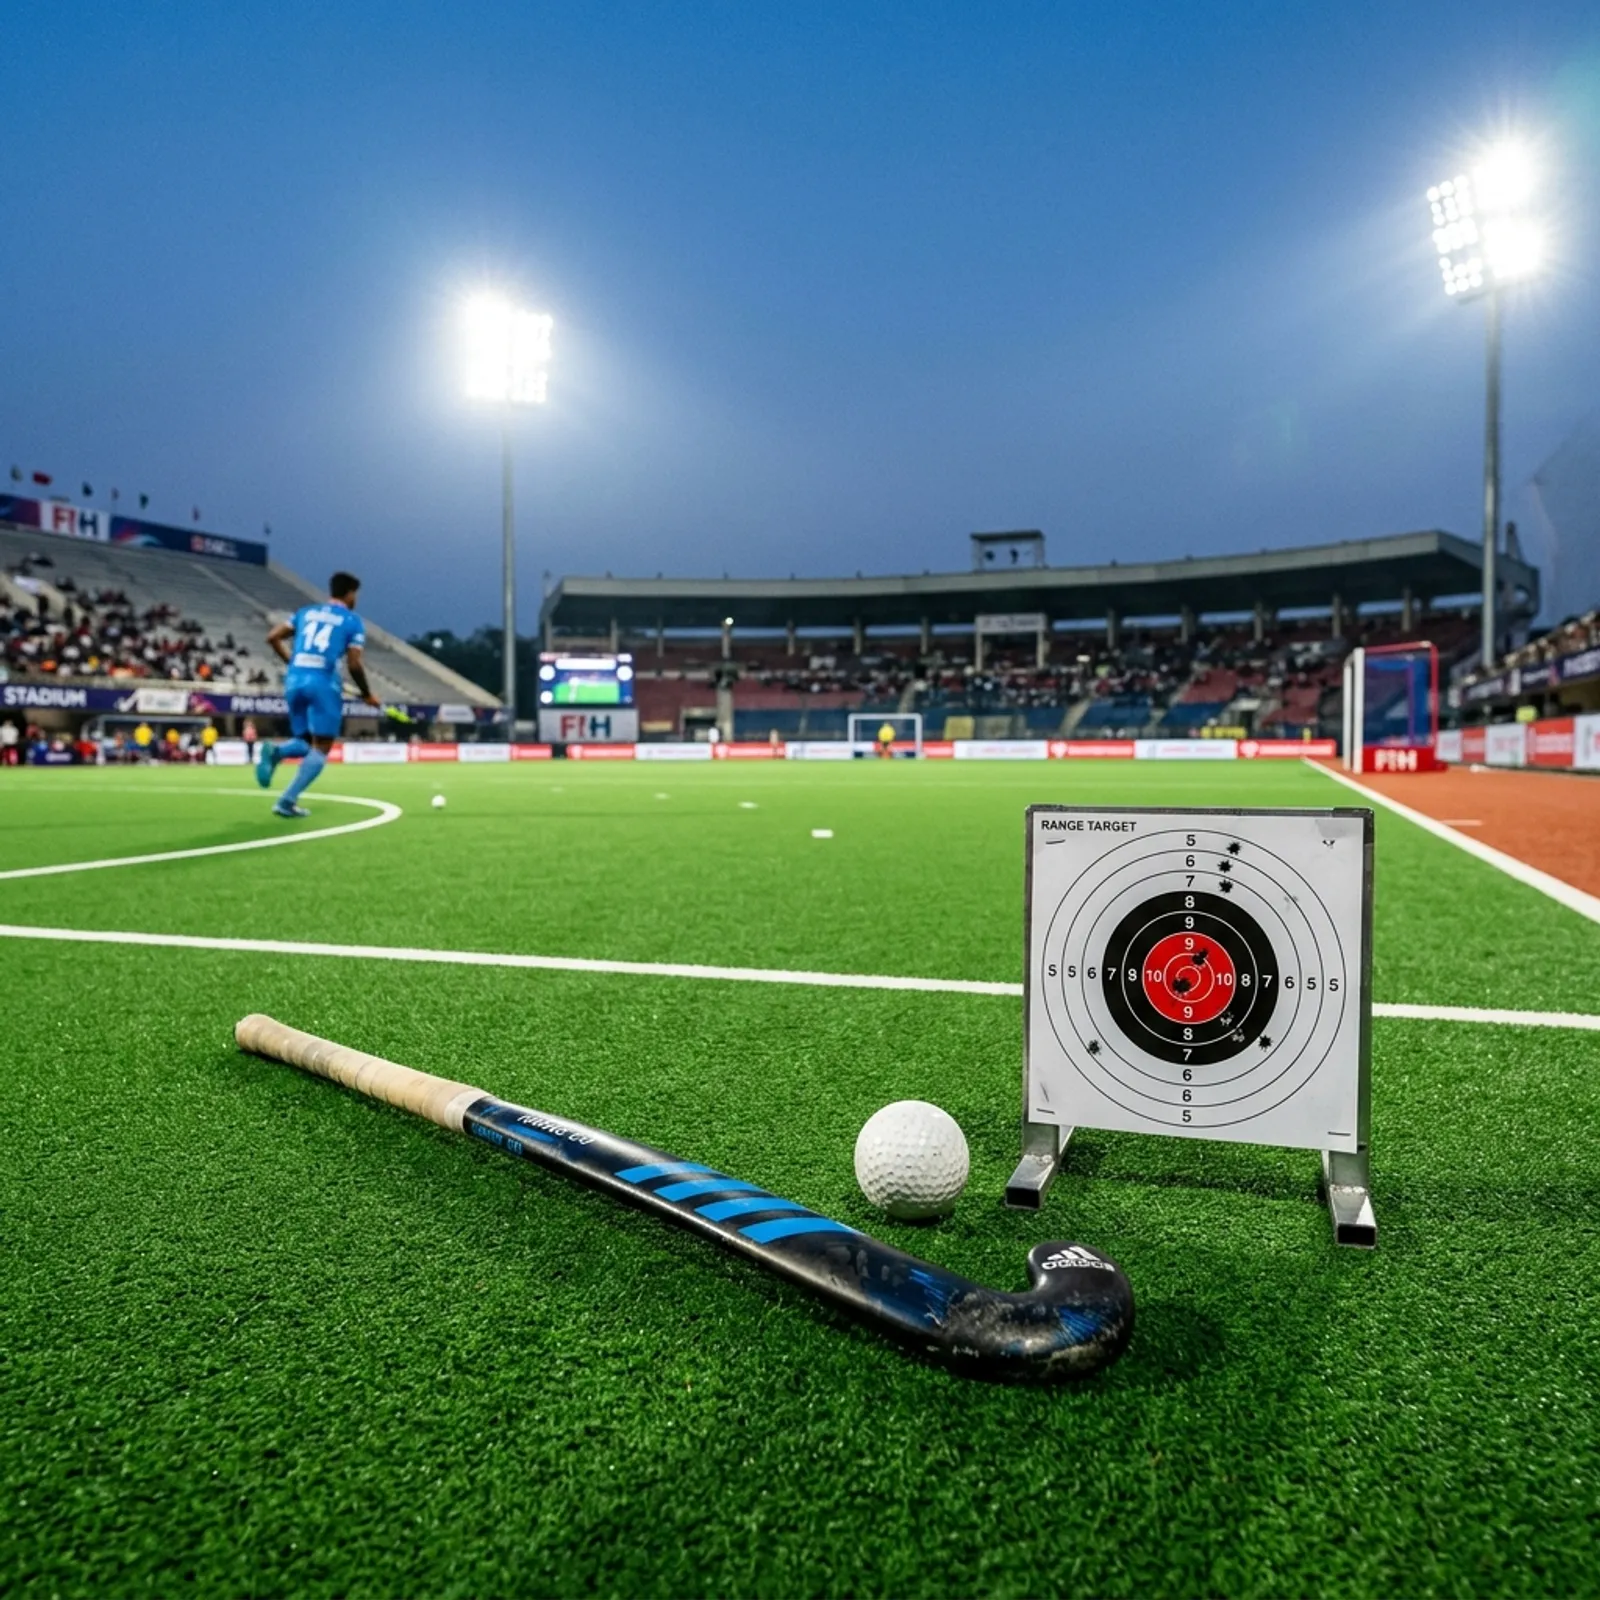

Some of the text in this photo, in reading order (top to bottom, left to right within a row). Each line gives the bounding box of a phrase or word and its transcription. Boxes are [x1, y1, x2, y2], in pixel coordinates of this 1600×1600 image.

[303, 620, 333, 653] 14
[4, 685, 87, 708] STADIUM
[560, 715, 611, 739] FIH
[1041, 820, 1137, 832] RANGE TARGET
[1185, 834, 1196, 847] 5
[1185, 855, 1195, 867] 6
[1185, 875, 1195, 887] 7
[1184, 895, 1195, 908] 8
[1185, 916, 1194, 929] 9
[1184, 937, 1194, 950] 9
[1048, 964, 1057, 977] 5
[1067, 965, 1077, 978] 5
[1087, 967, 1096, 979] 6
[1107, 967, 1117, 980] 7
[1146, 970, 1162, 982] 10
[1216, 973, 1232, 986] 10
[1241, 973, 1251, 987] 8
[1262, 975, 1273, 988] 7
[1284, 976, 1295, 989] 6
[1306, 977, 1316, 990] 5
[1329, 978, 1339, 991] 5
[1183, 1006, 1193, 1019] 9
[1183, 1027, 1193, 1040] 8
[1183, 1048, 1192, 1061] 7
[1183, 1069, 1192, 1081] 6
[1182, 1089, 1192, 1102] 6
[1182, 1109, 1192, 1122] 5
